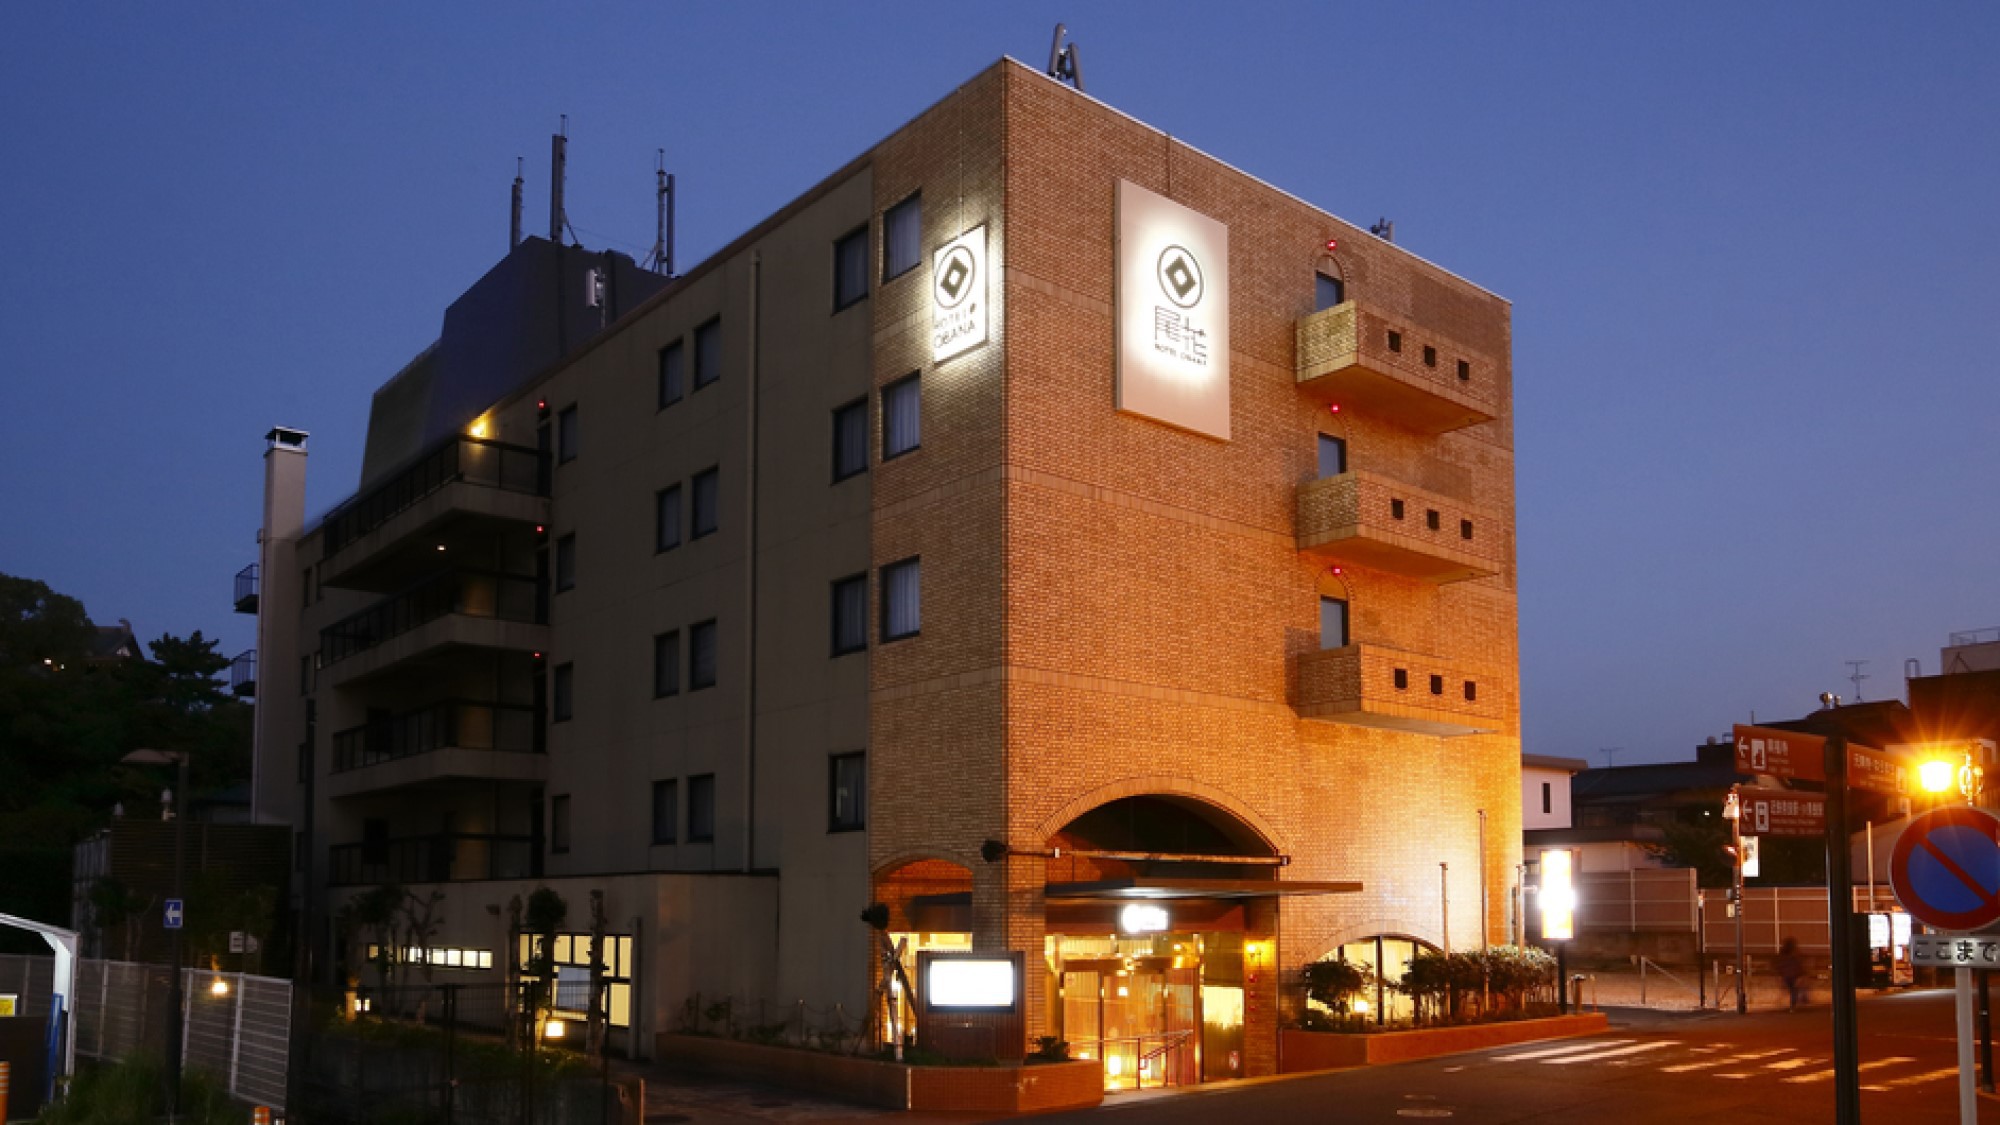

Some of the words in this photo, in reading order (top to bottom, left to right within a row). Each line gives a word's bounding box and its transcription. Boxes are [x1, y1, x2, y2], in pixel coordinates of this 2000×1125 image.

[934, 320, 975, 348] OBANA
[1155, 305, 1206, 357] 尾花
[1915, 940, 1998, 962] ここまで
